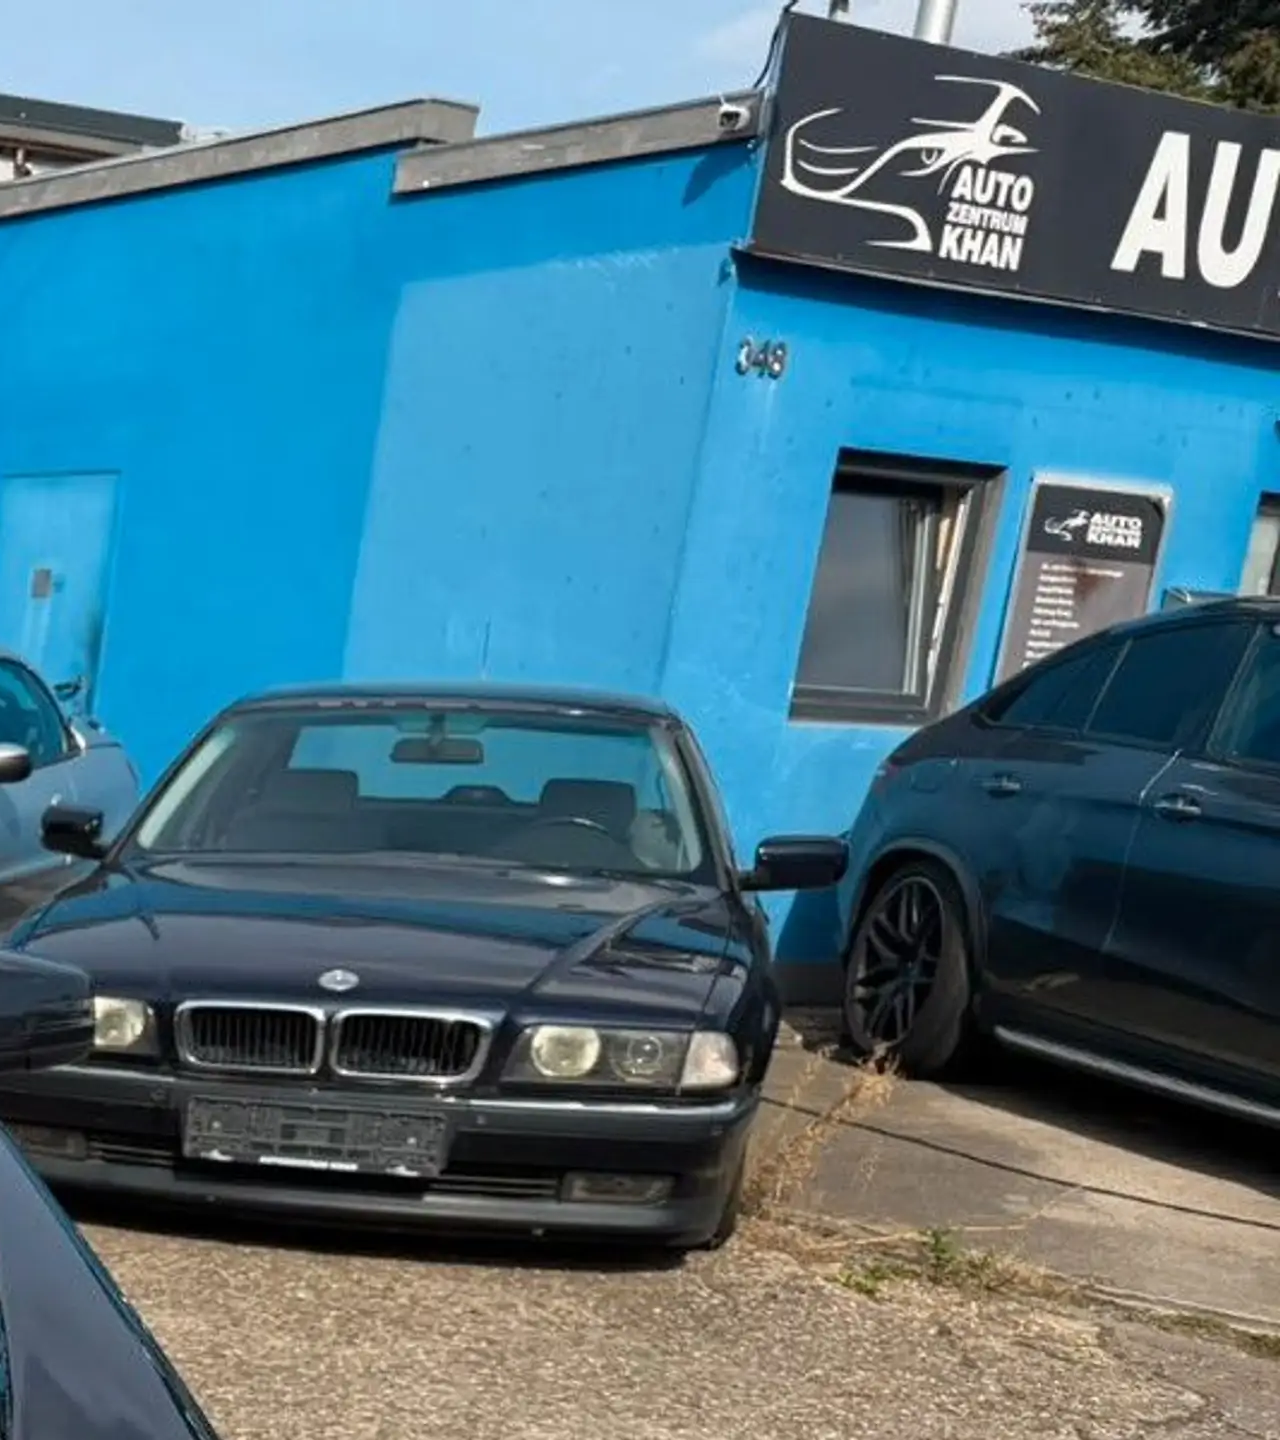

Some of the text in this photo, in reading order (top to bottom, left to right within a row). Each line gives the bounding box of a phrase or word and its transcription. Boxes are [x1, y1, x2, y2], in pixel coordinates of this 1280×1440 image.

[951, 165, 1034, 212] AUTO
[946, 201, 1029, 236] ZENTRUM
[939, 223, 1023, 271] KHAN
[1090, 512, 1141, 531] AUTO
[1086, 530, 1140, 549] KHAN
